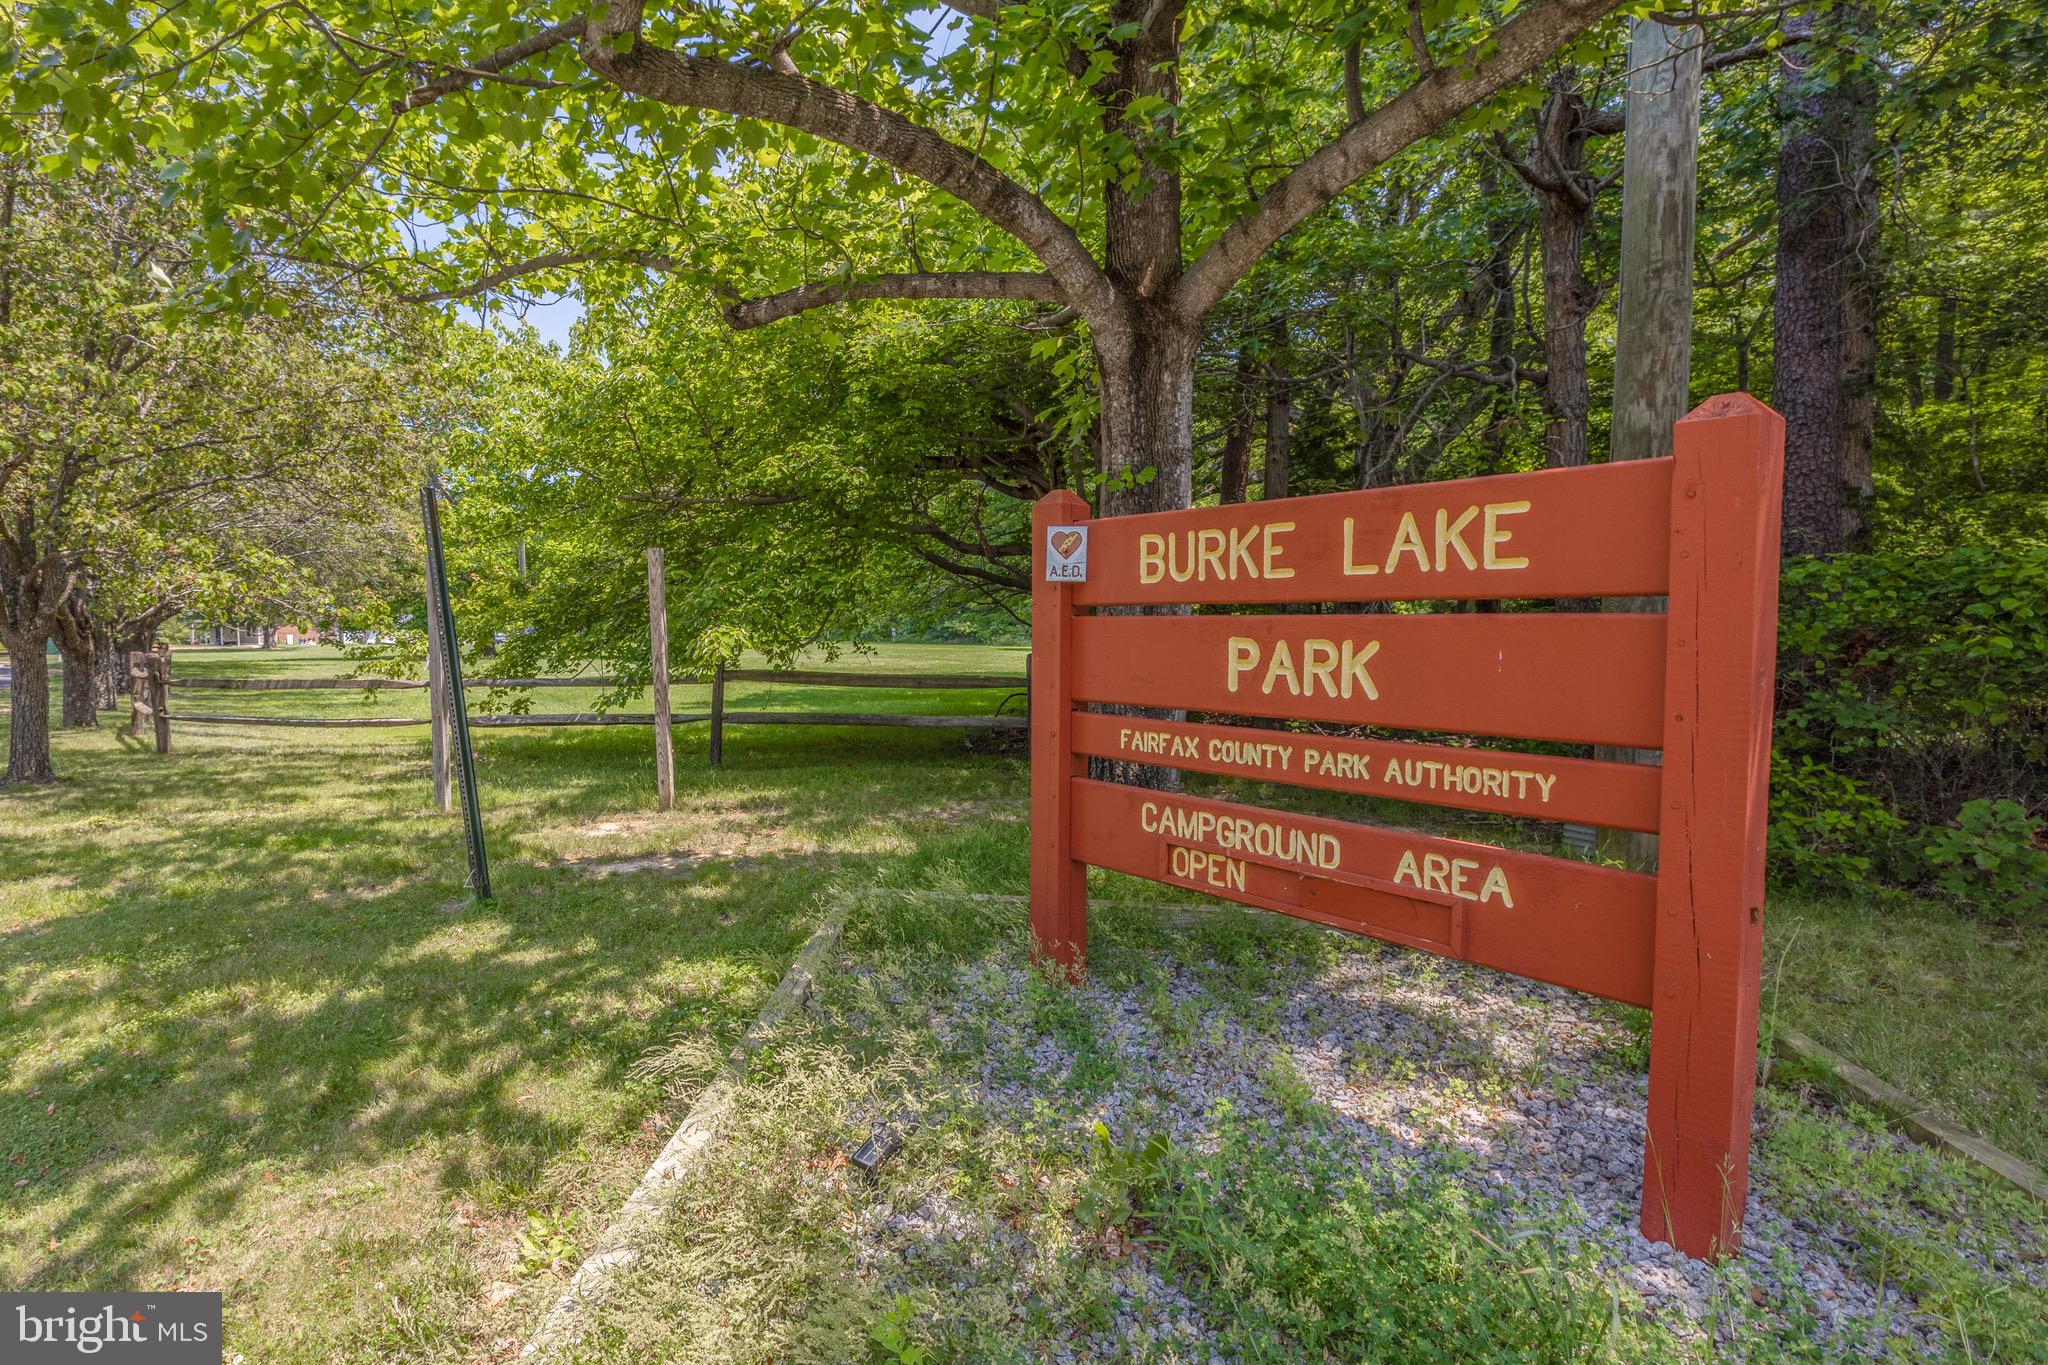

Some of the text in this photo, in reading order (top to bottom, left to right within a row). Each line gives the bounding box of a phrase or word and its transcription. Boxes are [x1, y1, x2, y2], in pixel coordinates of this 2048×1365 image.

[1050, 564, 1083, 577] A.E.D.
[1139, 500, 1531, 585] BURKE LAKE
[1227, 636, 1381, 700] PARK
[1120, 729, 1557, 802] FAIRFAX COUNTY PARK AUTHORITY
[1141, 801, 1514, 909] CAMPGROUND AREA
[1172, 847, 1247, 892] OPEN
